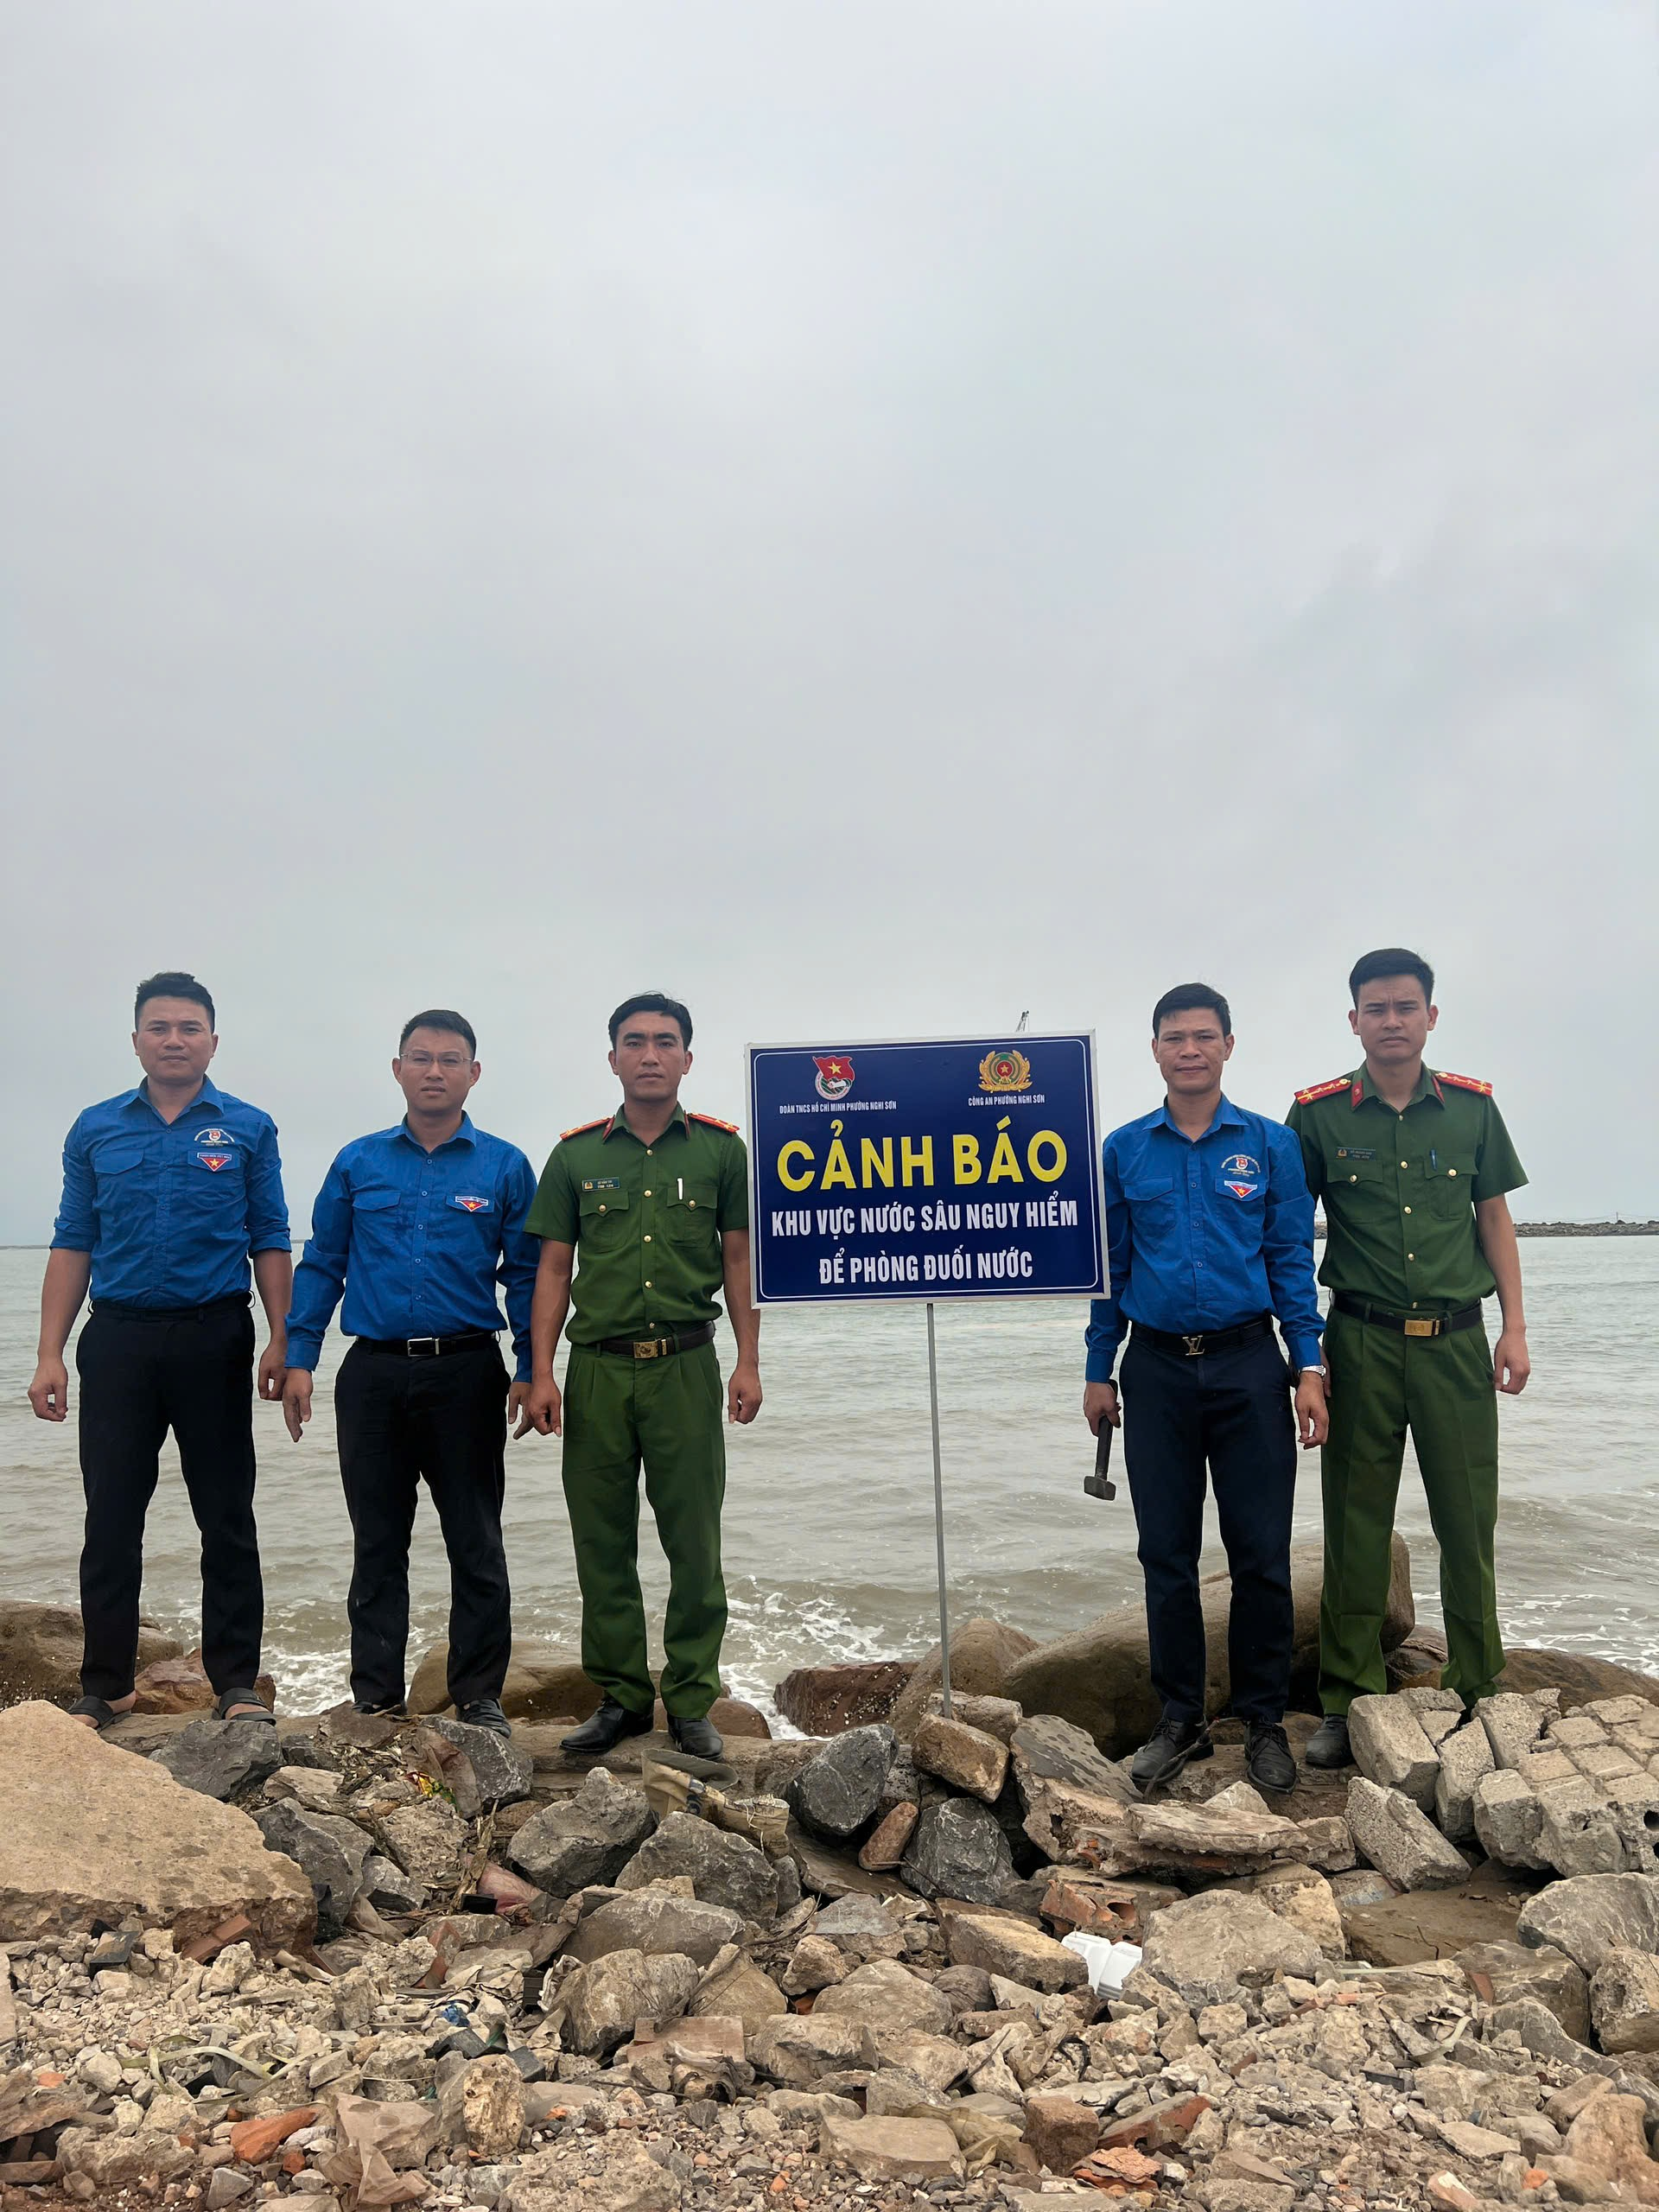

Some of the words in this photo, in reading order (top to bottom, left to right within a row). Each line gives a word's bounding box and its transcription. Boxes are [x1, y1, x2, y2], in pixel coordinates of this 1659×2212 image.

[779, 1103, 795, 1115] ĐOÀN
[796, 1103, 810, 1114] TNCS
[820, 1102, 830, 1113] CHÍ
[830, 1103, 845, 1112] MINH
[846, 1100, 869, 1111] PHƯỜNG
[870, 1101, 884, 1111] NGHI
[885, 1100, 897, 1110] SƠN
[968, 1096, 984, 1107] CÔNG
[985, 1096, 993, 1106] AN
[994, 1094, 1017, 1105] PHƯỜNG
[1018, 1095, 1032, 1104] NGHI
[1033, 1093, 1046, 1103] SƠN
[777, 1119, 934, 1192] CẢNH
[952, 1115, 1067, 1185] BÁO
[772, 1210, 811, 1236] KHU
[816, 1206, 855, 1240] VỰC
[860, 1201, 915, 1233] NƯỚC
[920, 1199, 961, 1231] SÂU
[966, 1202, 1020, 1230] NGUY
[1026, 1190, 1078, 1228] HIỂM
[819, 1247, 845, 1284] ĐỂ
[850, 1249, 918, 1283] PHÒNG
[923, 1244, 972, 1281] ĐUỐI
[976, 1246, 1033, 1279] NƯỚC
